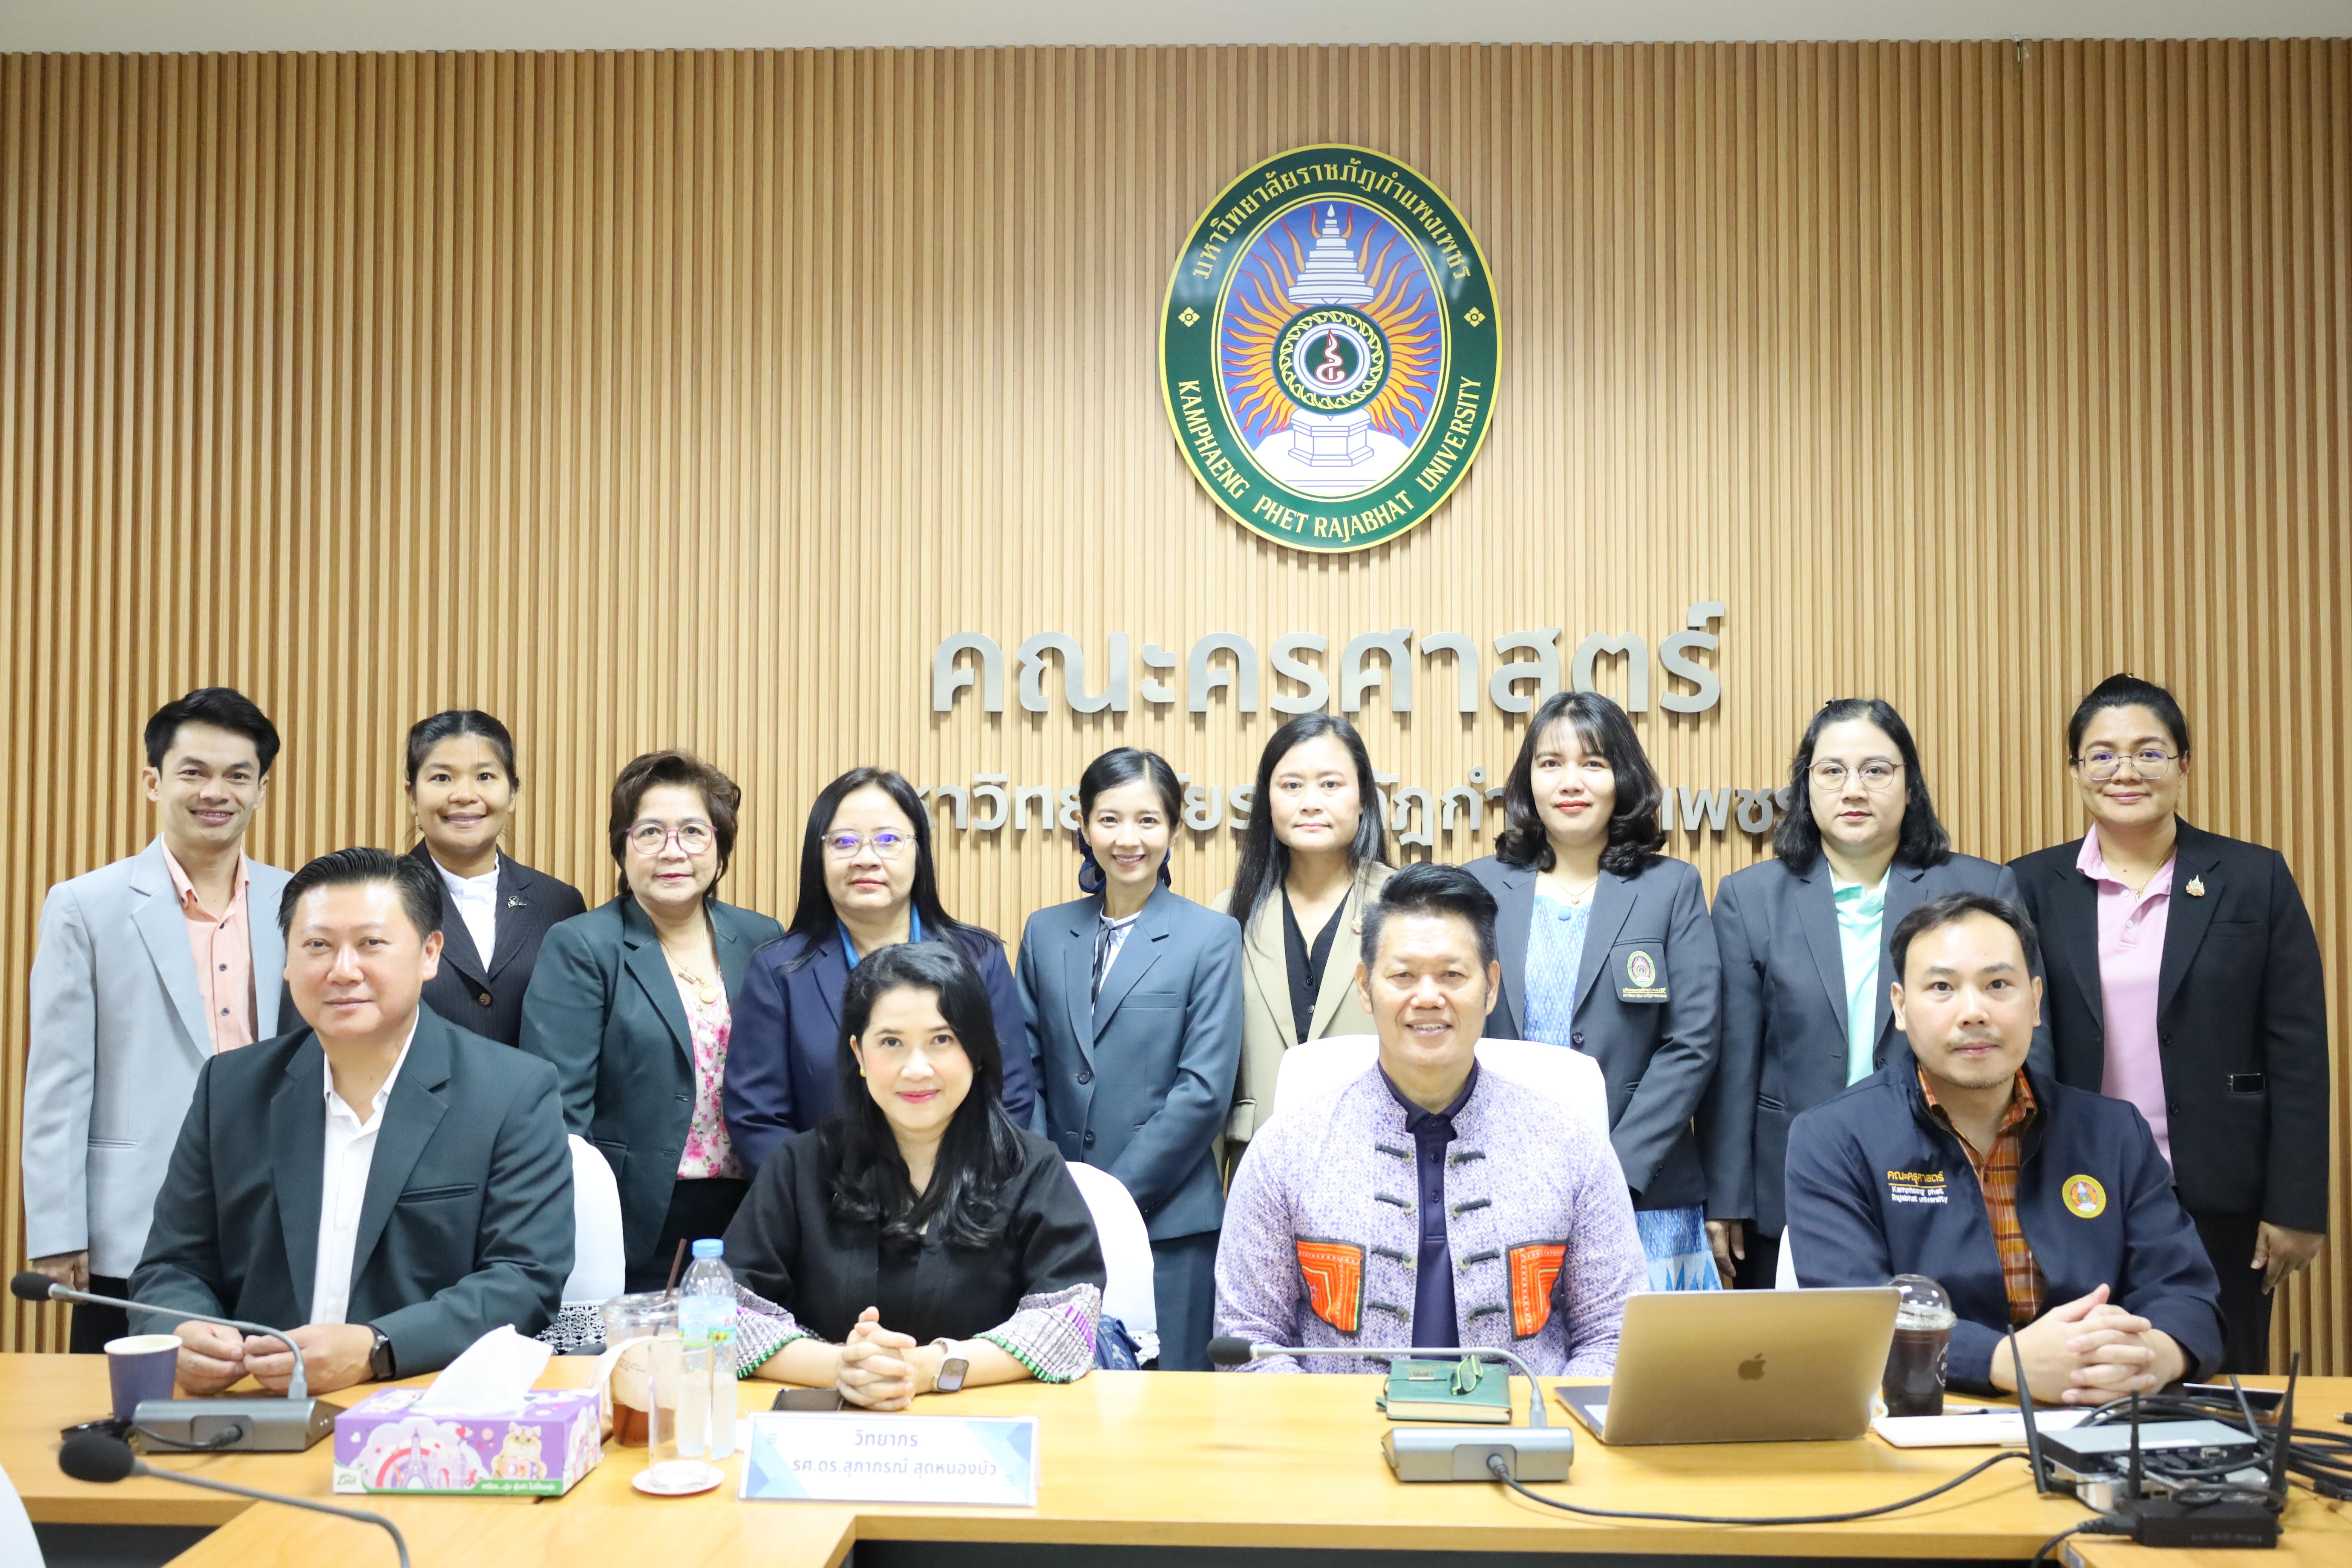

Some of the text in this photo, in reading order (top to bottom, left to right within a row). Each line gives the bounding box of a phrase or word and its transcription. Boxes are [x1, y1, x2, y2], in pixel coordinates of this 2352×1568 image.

[1193, 157, 1471, 280] มหาวิทยาลัยราชภัฏกำแพงเพชร
[1178, 377, 1482, 543] KAMPHAENG PHET RAJABHAT UNIVERSITY
[933, 601, 1725, 714] คณะครศาสตร์
[1887, 1171, 1945, 1185] คณะครุศาสตร์
[793, 1458, 997, 1478] รศ.ดร.สุภาภรณ์ สุดหนองบัว
[854, 1430, 918, 1447] วิทยากร
